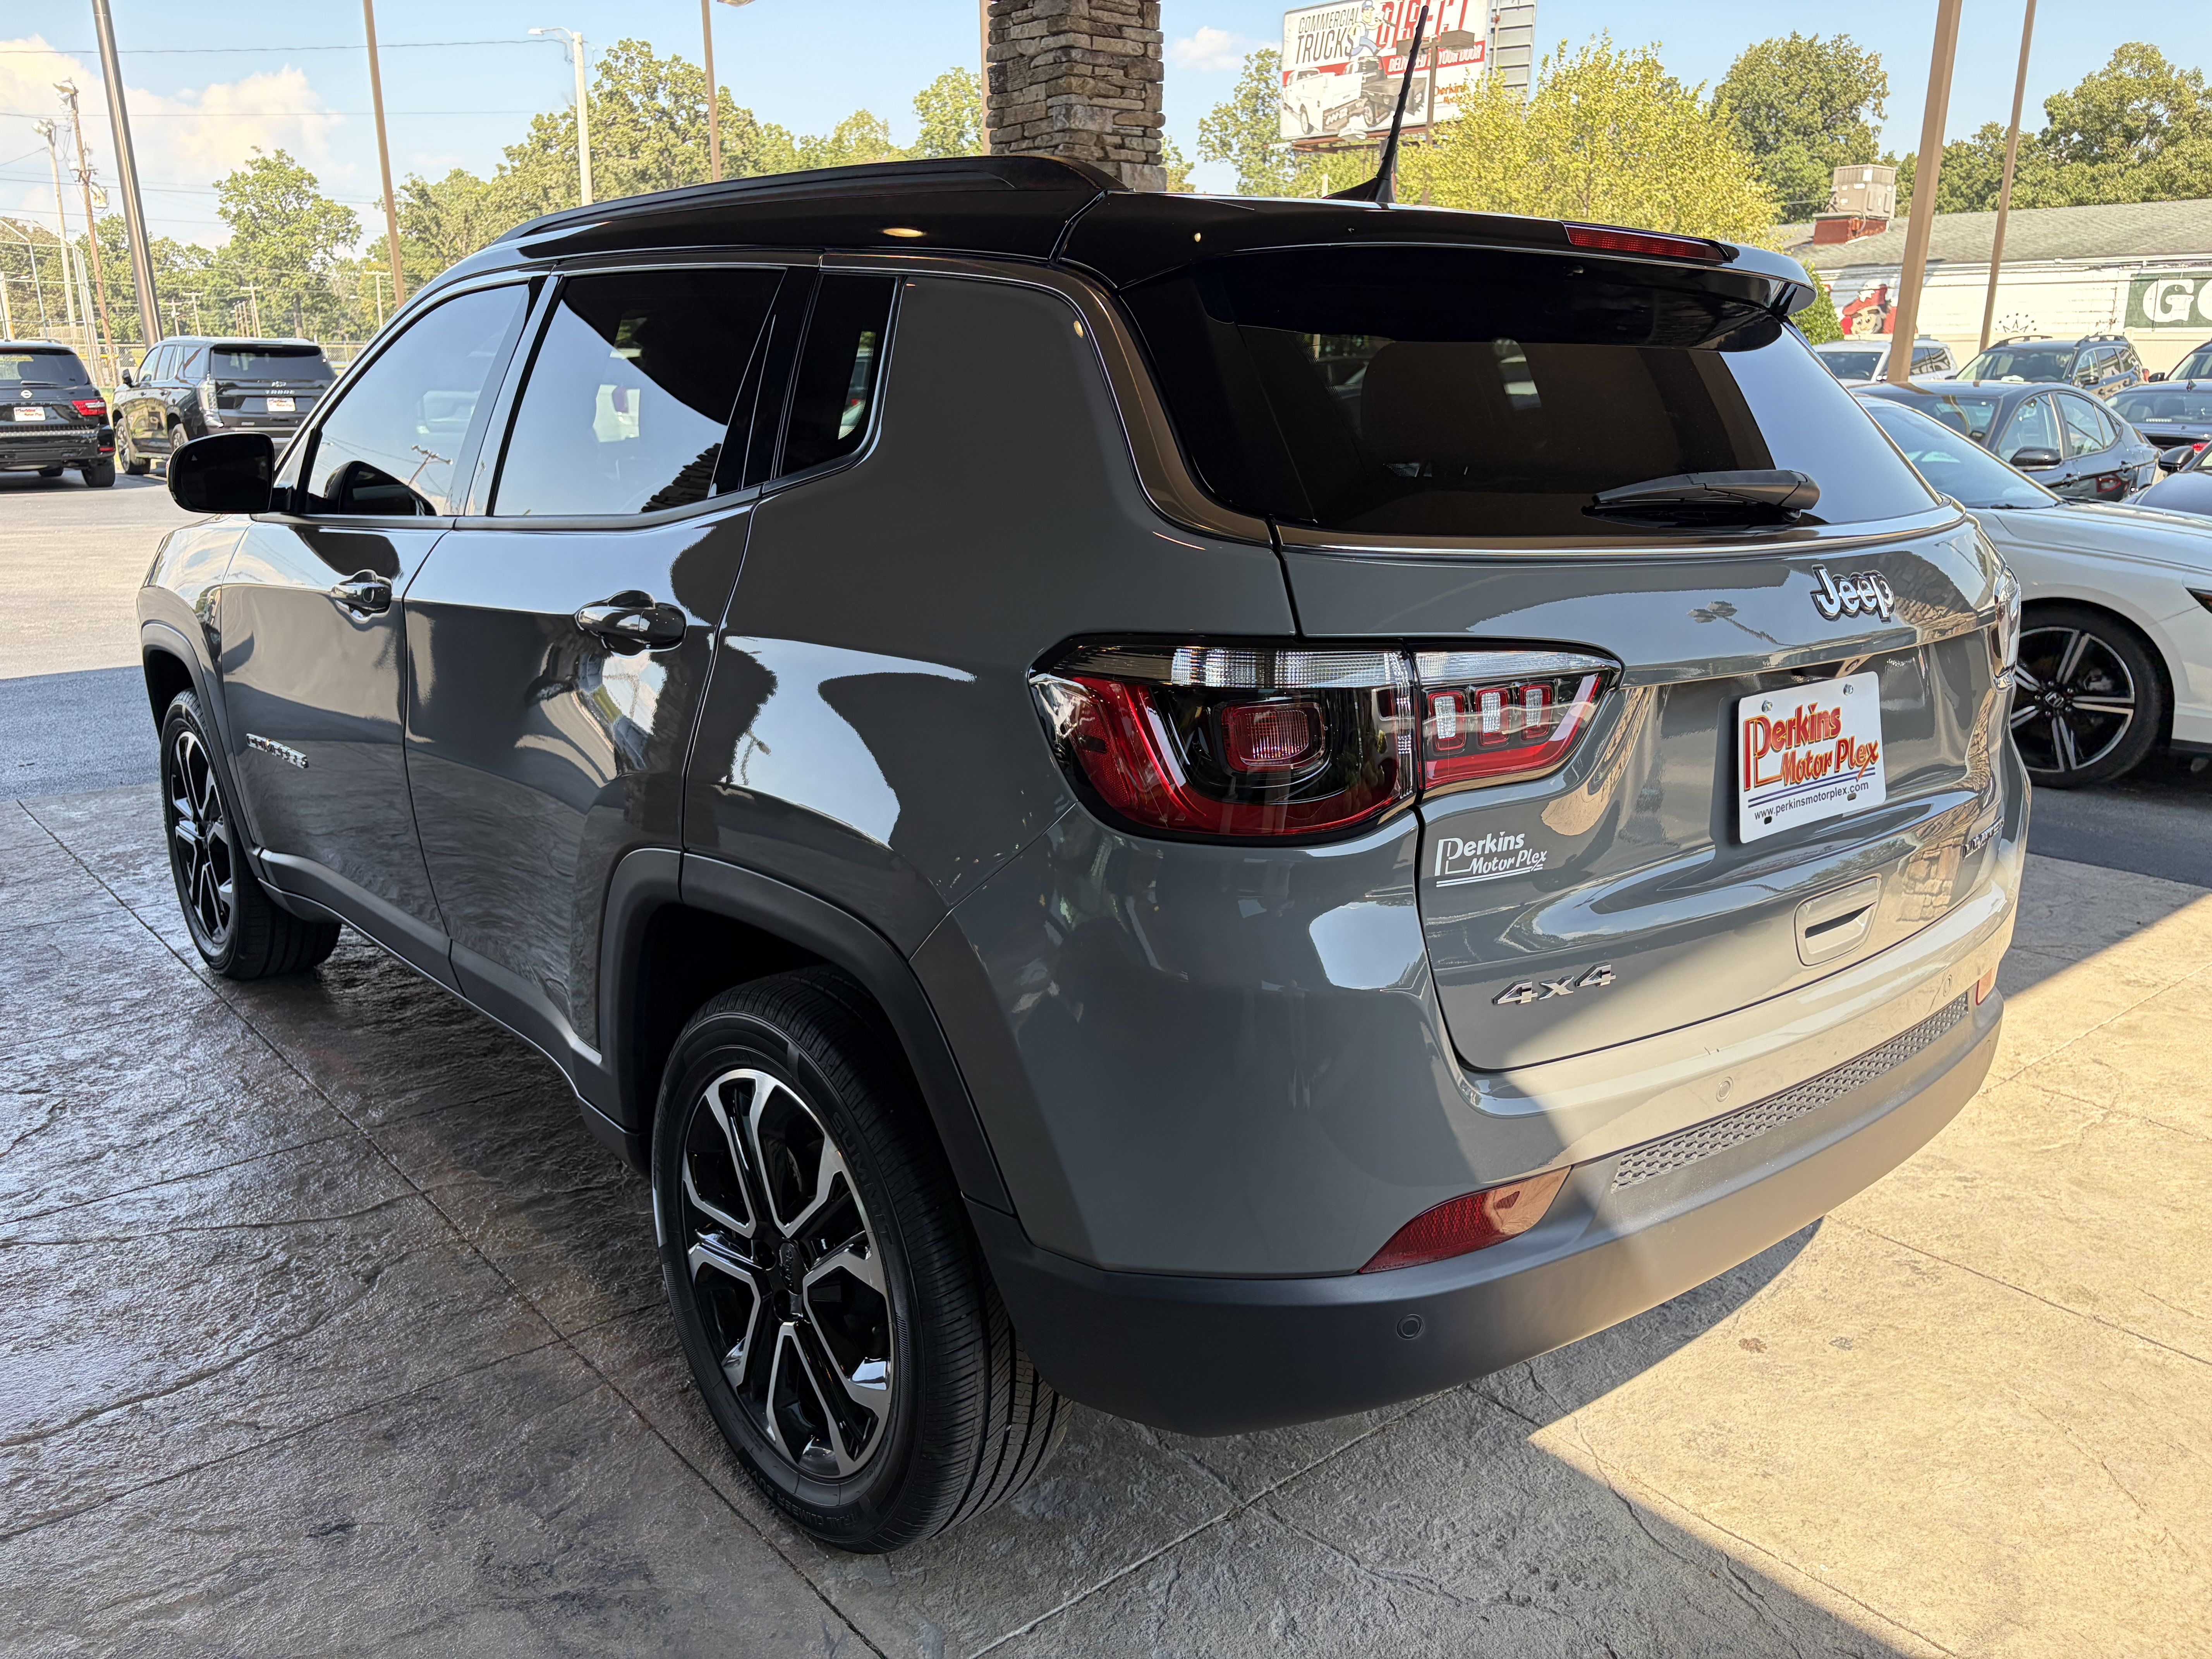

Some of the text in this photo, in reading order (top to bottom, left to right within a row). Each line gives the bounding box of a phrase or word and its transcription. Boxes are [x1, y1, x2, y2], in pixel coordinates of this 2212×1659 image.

[1298, 7, 1359, 34] COMMERCIAL
[1296, 27, 1354, 64] TRUCKS
[1810, 564, 1896, 623] Jeep
[1743, 702, 1842, 793] Perkins
[1781, 735, 1879, 787] Motor Plex
[1754, 781, 1869, 820] www.perkinsmotorplex.com
[1434, 831, 1525, 876] Perkins
[1469, 848, 1547, 874] Motor Plex
[831, 1111, 894, 1245] SUMMIT
